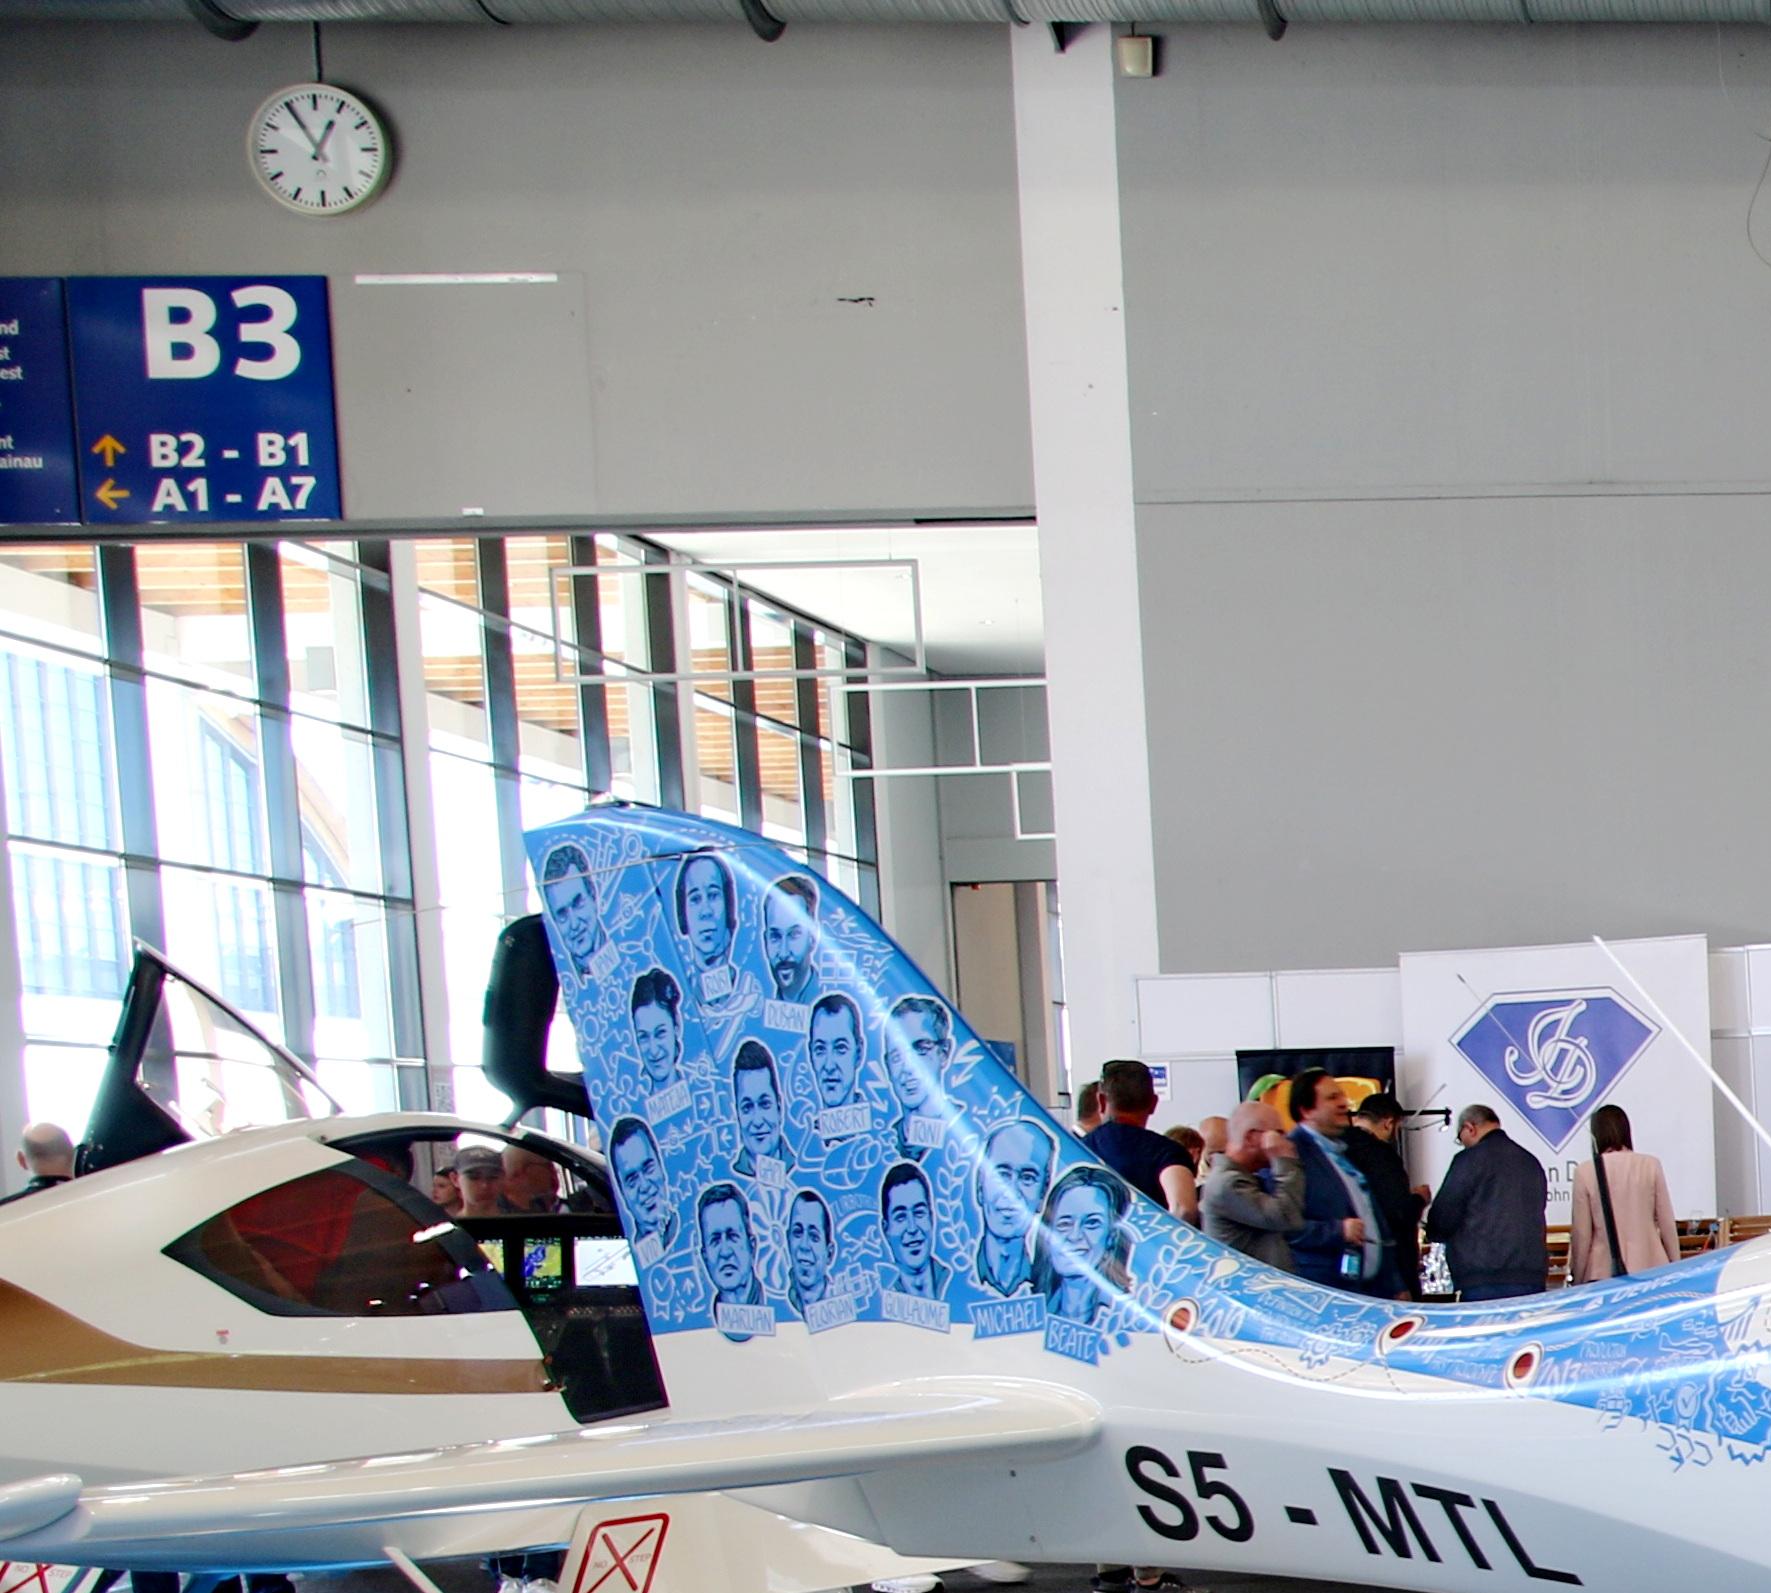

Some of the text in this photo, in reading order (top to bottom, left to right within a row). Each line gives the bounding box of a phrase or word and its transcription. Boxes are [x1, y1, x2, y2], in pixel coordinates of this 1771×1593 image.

[141, 285, 301, 381] B3
[149, 433, 206, 468] B2
[257, 432, 309, 467] B1
[152, 478, 208, 512] A1
[257, 476, 317, 511] A7
[974, 1300, 1044, 1335] MICHAEL
[1047, 1322, 1099, 1362] BEATE
[1124, 1445, 1255, 1543] S5
[1328, 1467, 1585, 1587] MTL
[629, 1552, 652, 1564] STEP
